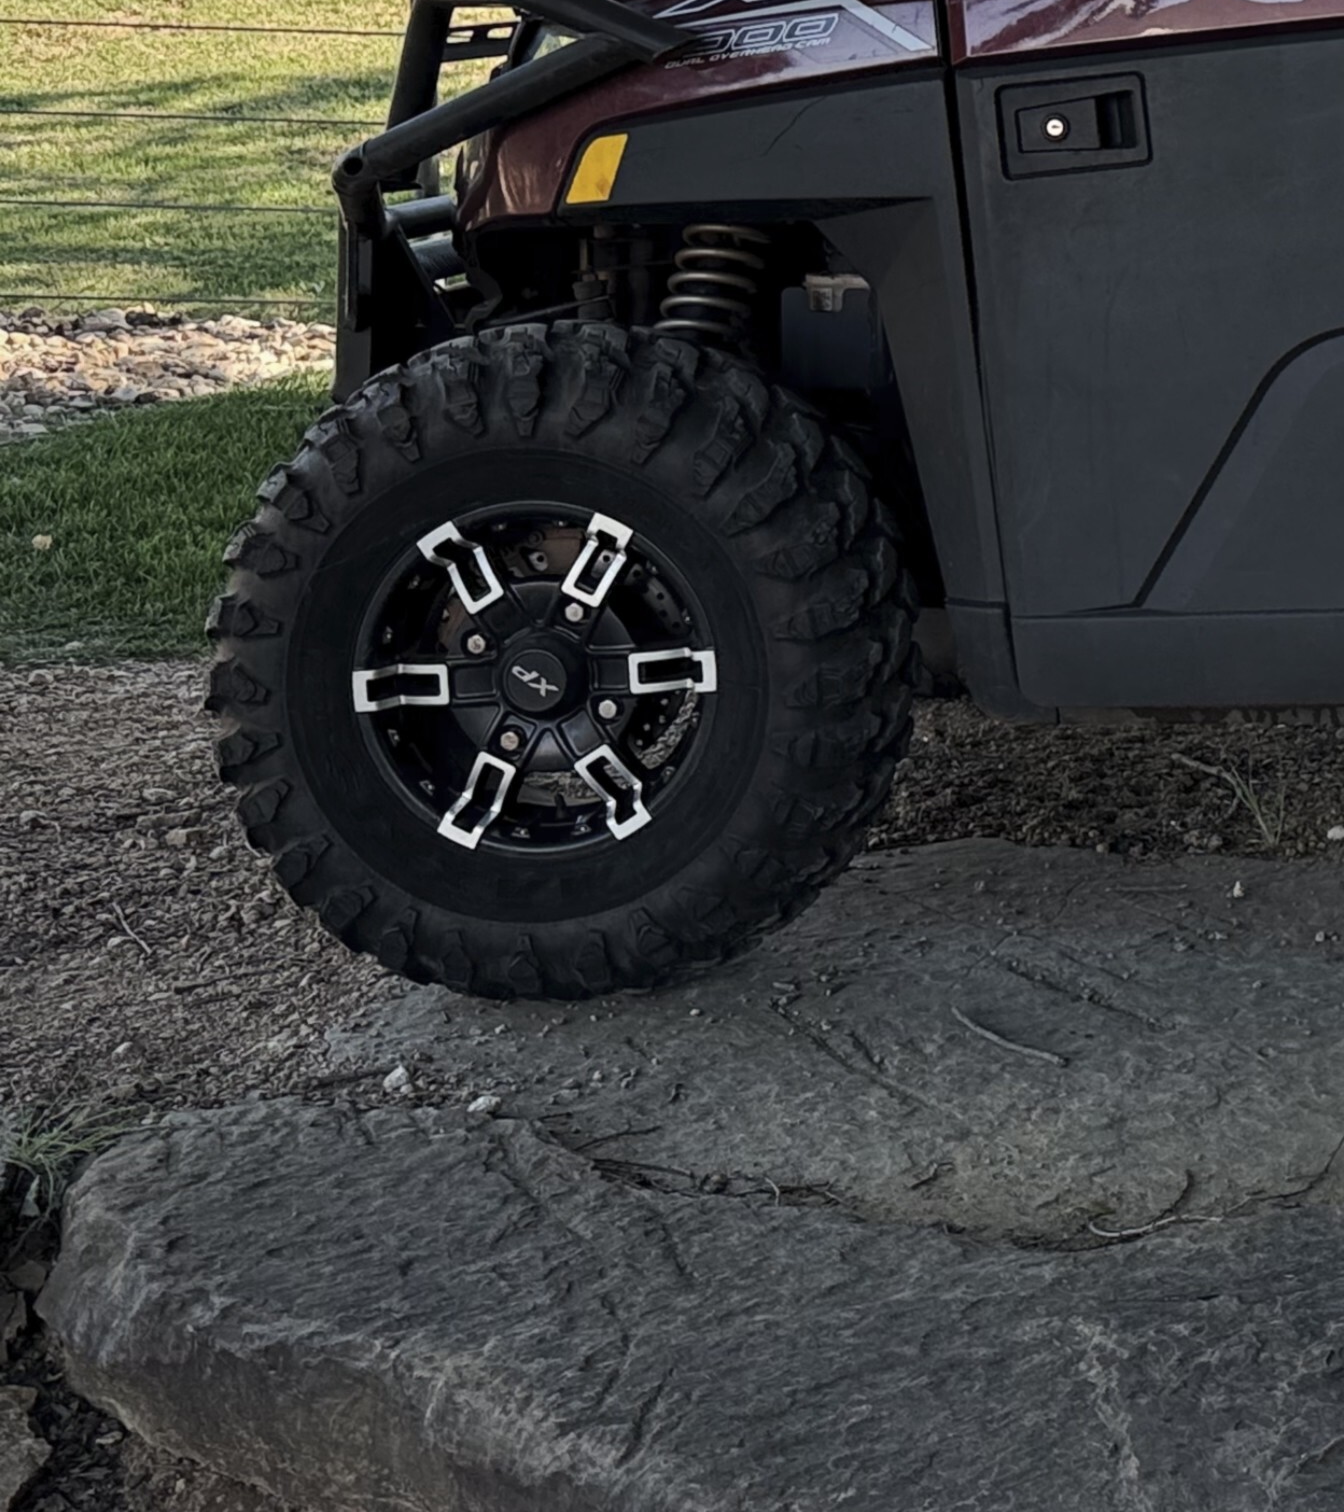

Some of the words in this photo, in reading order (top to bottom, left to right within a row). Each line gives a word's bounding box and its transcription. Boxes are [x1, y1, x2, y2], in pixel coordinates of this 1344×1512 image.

[680, 12, 839, 59] 000
[664, 56, 705, 69] DUAL
[708, 43, 794, 62] OVERHEAD
[794, 37, 832, 50] CAM
[511, 665, 560, 698] XP
